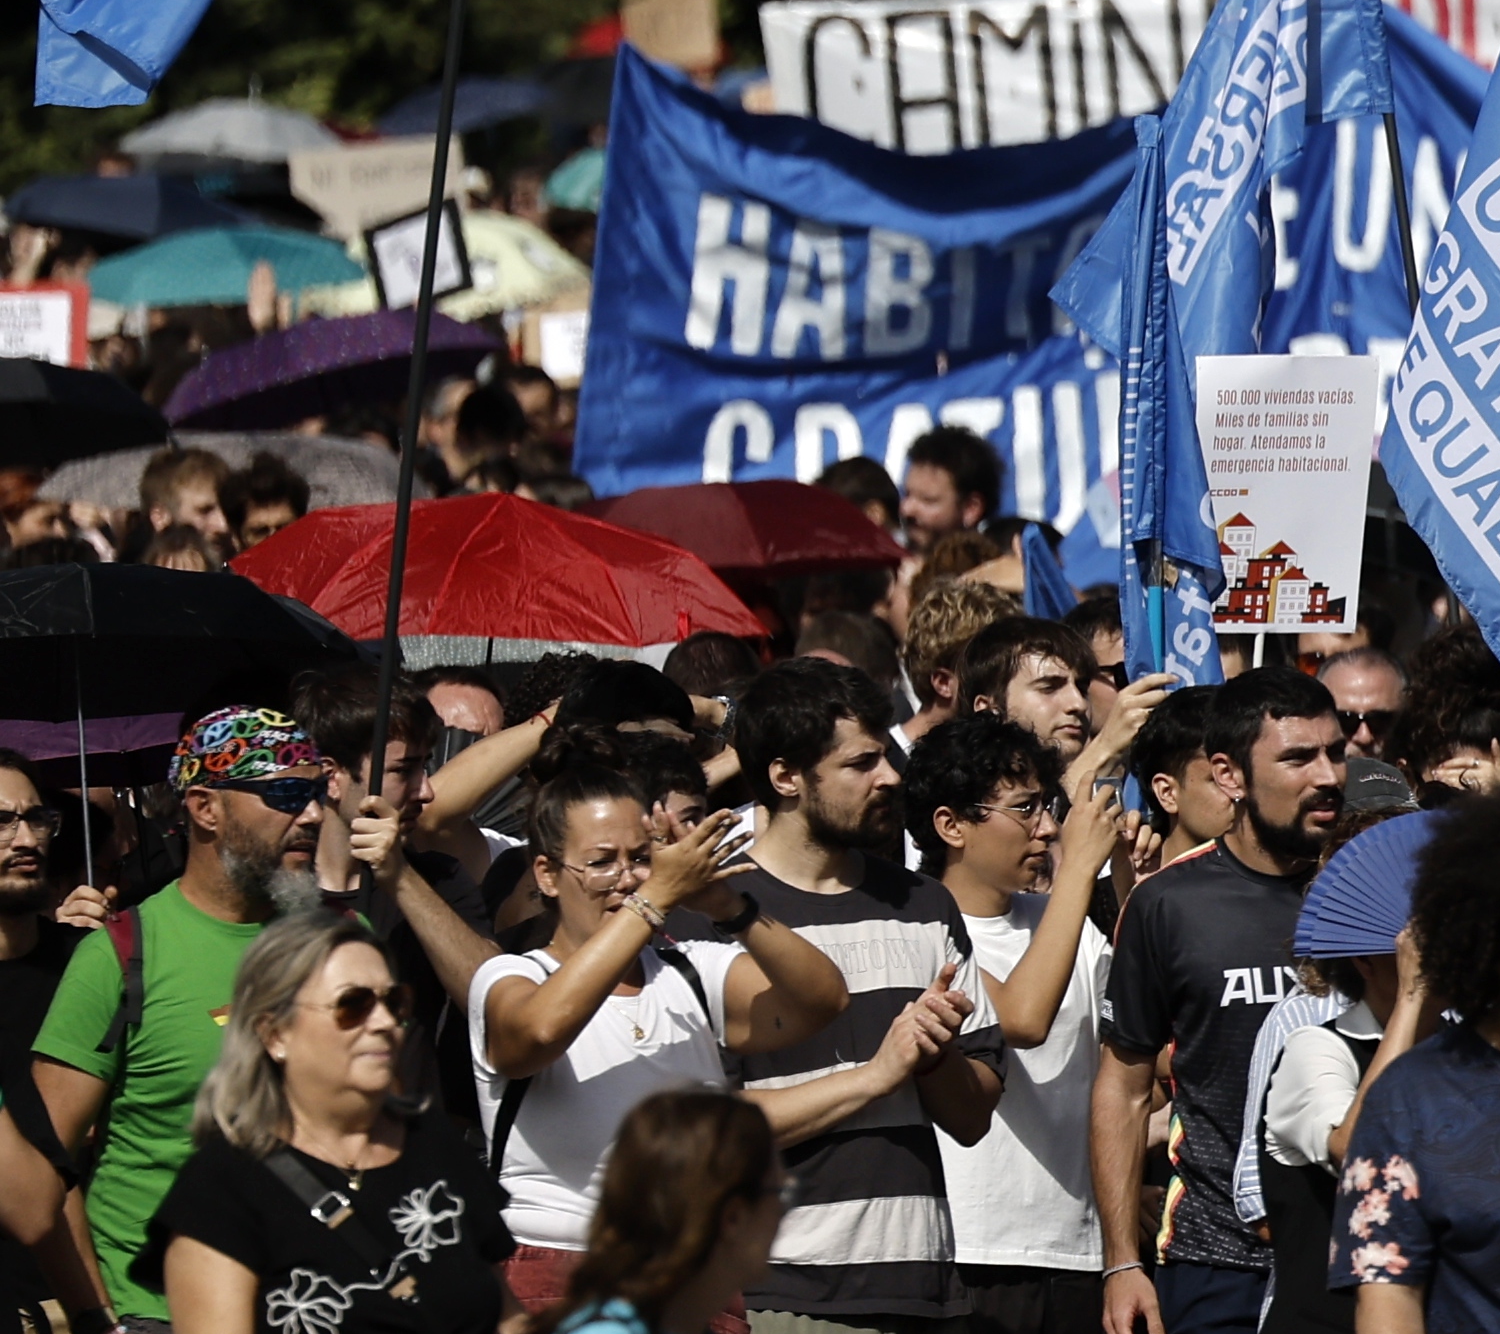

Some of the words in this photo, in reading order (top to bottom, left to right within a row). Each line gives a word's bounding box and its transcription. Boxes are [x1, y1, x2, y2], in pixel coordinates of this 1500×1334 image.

[1217, 390, 1261, 406] 500.000
[1264, 389, 1315, 405] viviendas
[1318, 388, 1356, 405] vacías.
[1215, 412, 1244, 428] Miles
[1247, 412, 1260, 428] de
[1264, 411, 1308, 427] familias
[1311, 412, 1329, 427] sin
[1213, 435, 1247, 452] hogar.
[1250, 434, 1312, 450] Atendamos
[1315, 434, 1326, 449] la
[1210, 457, 1275, 474] emergencia
[1277, 456, 1351, 473] habitacional.
[1209, 489, 1238, 497] CCOO
